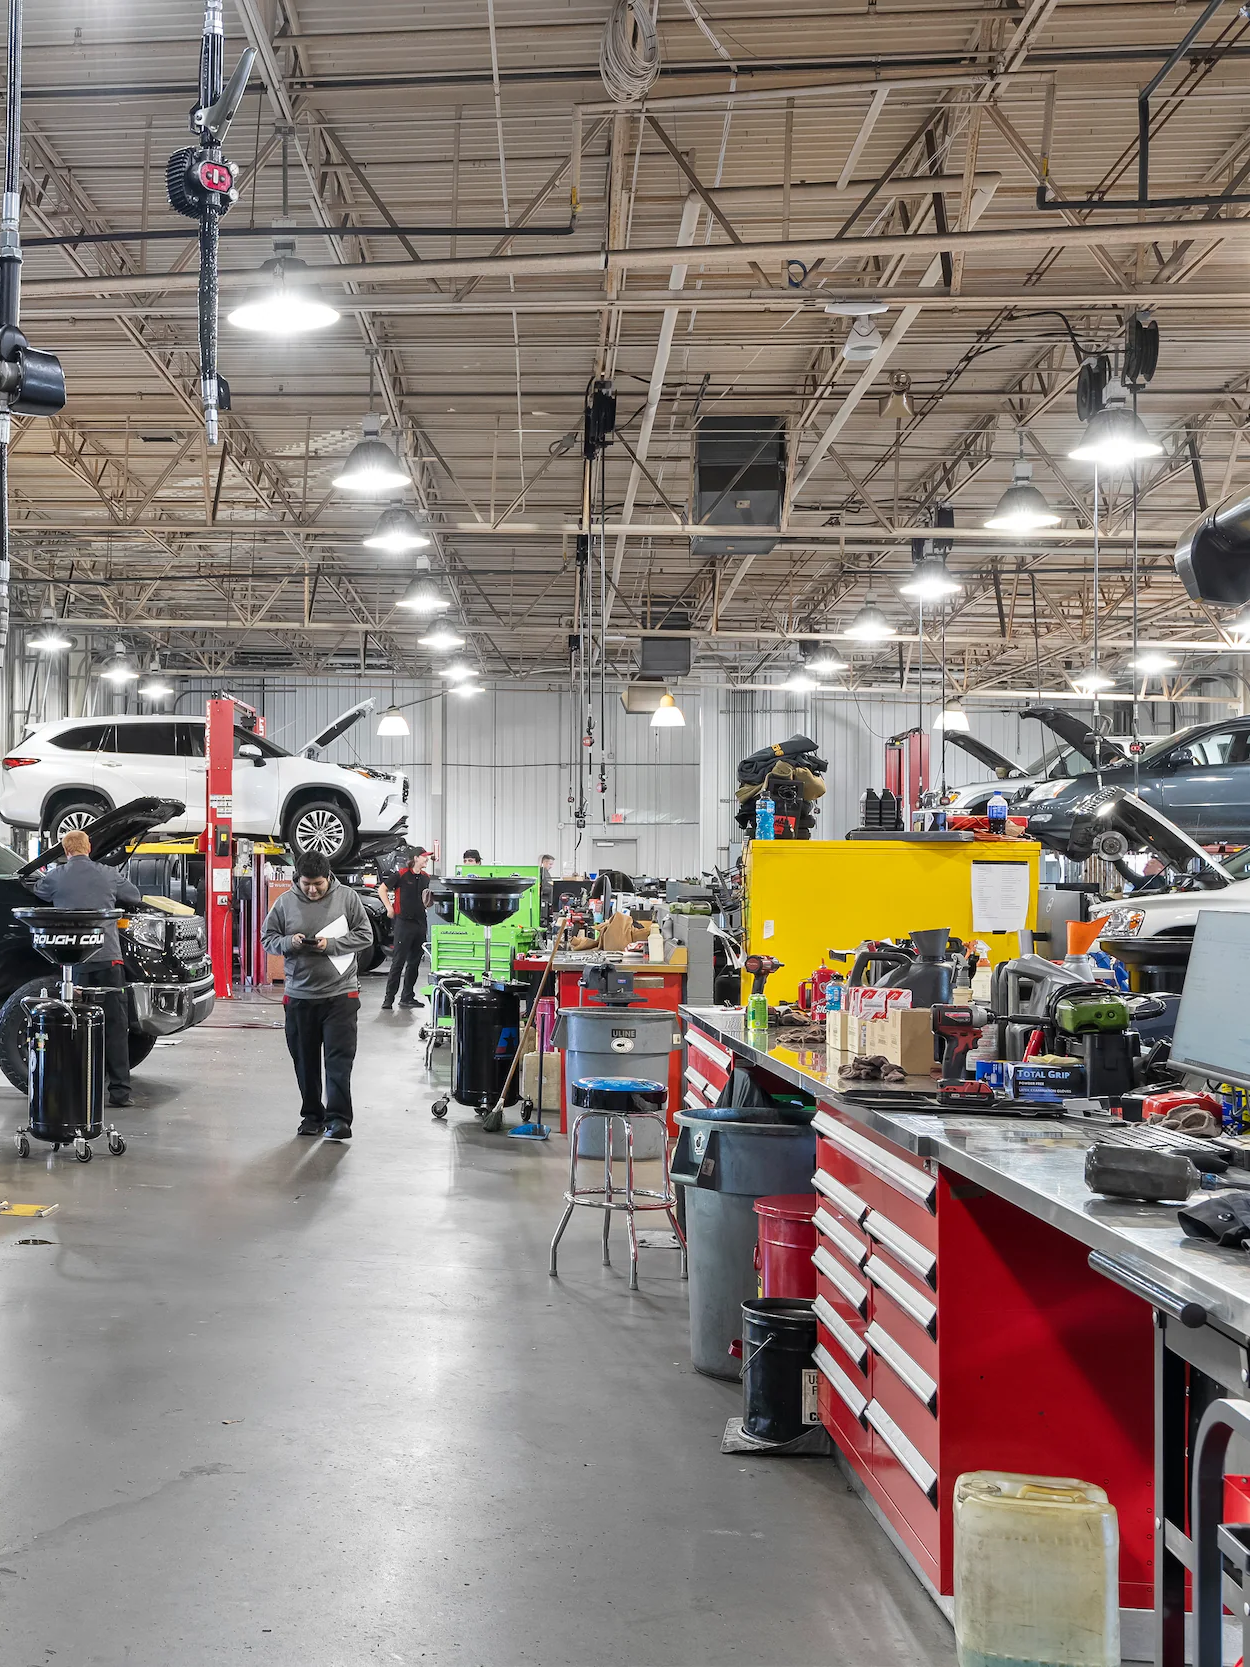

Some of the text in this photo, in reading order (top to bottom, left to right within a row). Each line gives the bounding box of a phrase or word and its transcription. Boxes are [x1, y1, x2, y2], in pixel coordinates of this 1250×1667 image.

[33, 934, 77, 945] ROUGH
[612, 1029, 636, 1038] ULINE
[1017, 1069, 1070, 1079] TOTAL GRIP
